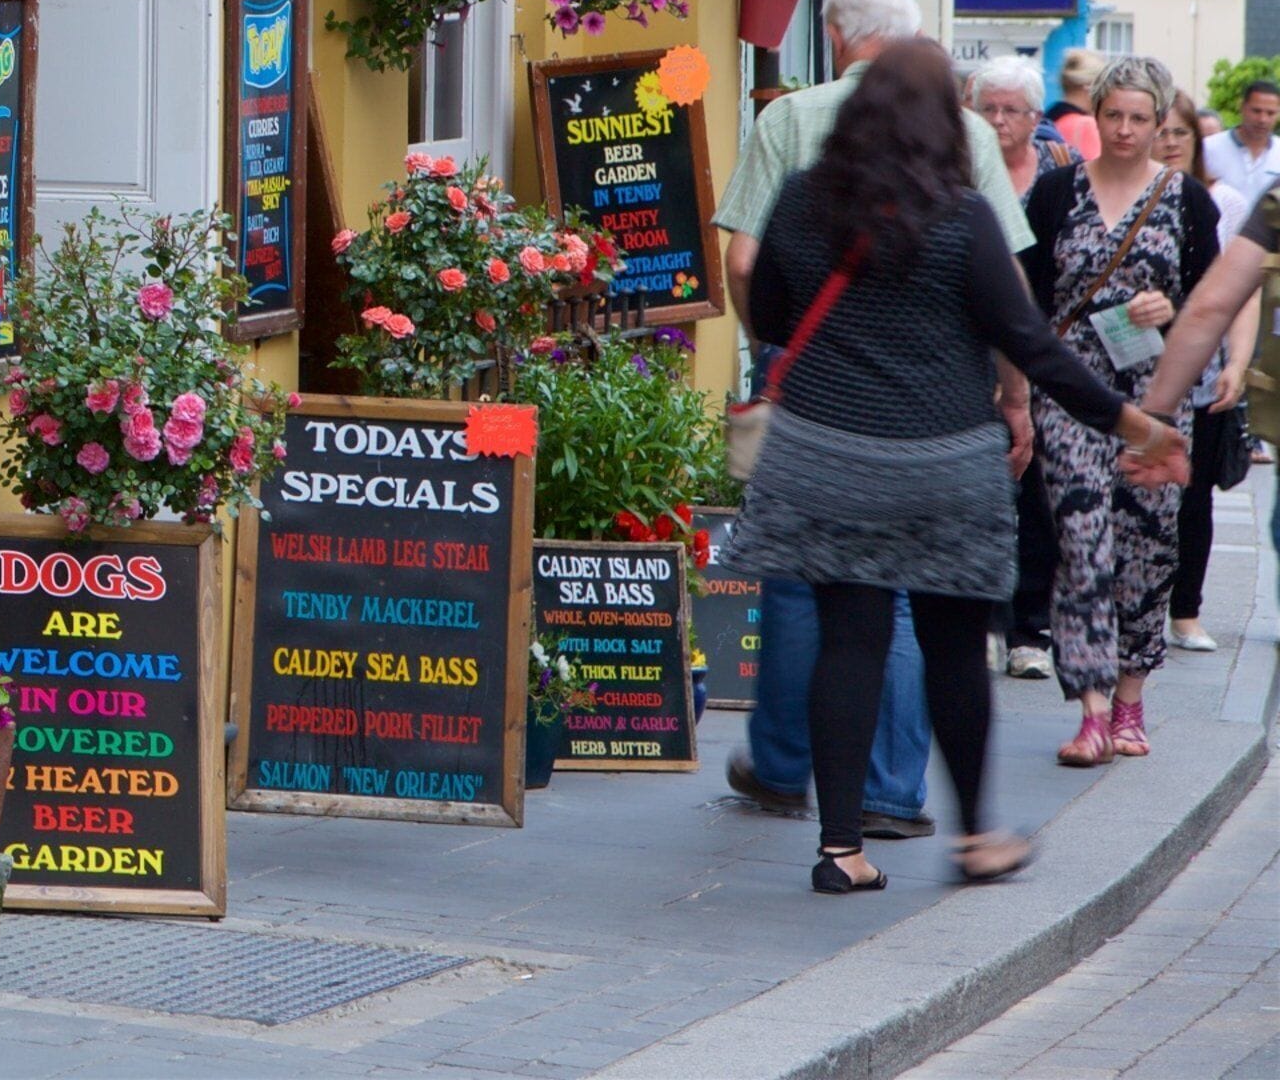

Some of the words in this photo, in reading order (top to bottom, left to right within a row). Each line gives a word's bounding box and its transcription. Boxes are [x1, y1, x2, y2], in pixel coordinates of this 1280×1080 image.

[248, 117, 279, 138] CURRIES
[567, 110, 674, 144] SUNNIEST
[603, 144, 643, 164] BEER
[595, 163, 657, 185] GARDEN
[594, 188, 609, 207] IN
[614, 183, 662, 205] TENBY
[602, 209, 658, 230] PLENTY
[623, 229, 669, 249] ROOM
[625, 251, 693, 275] STRAIGHT
[304, 421, 479, 461] TODAYS
[281, 471, 500, 514] SPECIALS
[271, 533, 332, 562] WELSH
[337, 538, 388, 566] LAMB
[393, 540, 426, 567] LEG
[432, 542, 490, 571] STEAK
[538, 555, 604, 579] CALDEY
[608, 557, 671, 580] ISLAND
[559, 581, 599, 604] SEA
[604, 582, 655, 606] BASS
[283, 591, 353, 621] TENBY
[361, 597, 480, 629] MACKEREL
[544, 610, 586, 626] WHOLE,
[590, 611, 672, 627] OVEN-ROASTED
[42, 611, 123, 640] ARE
[557, 638, 589, 652] WITH
[593, 639, 627, 653] ROCK
[631, 639, 663, 653] SALT
[273, 647, 359, 679] CALDEY
[366, 652, 410, 682] SEA
[419, 656, 479, 687] BASS
[581, 665, 617, 679] THICK
[621, 666, 662, 680] FILLET
[19, 687, 56, 713] IN
[68, 689, 147, 717] OUR
[266, 704, 358, 735] PEPPERED
[364, 710, 414, 739] PORK
[420, 714, 483, 744] FILLET
[568, 715, 611, 730] LEMON
[631, 717, 679, 731] GARLIC
[571, 741, 607, 755] HERB
[611, 742, 661, 756] BUTTER
[27, 765, 179, 797] HEATED
[258, 760, 331, 792] SALMON
[342, 767, 388, 795] "NEW
[395, 770, 483, 802] ORLEANS"
[33, 805, 134, 835] BEER
[3, 843, 164, 876] GARDEN
